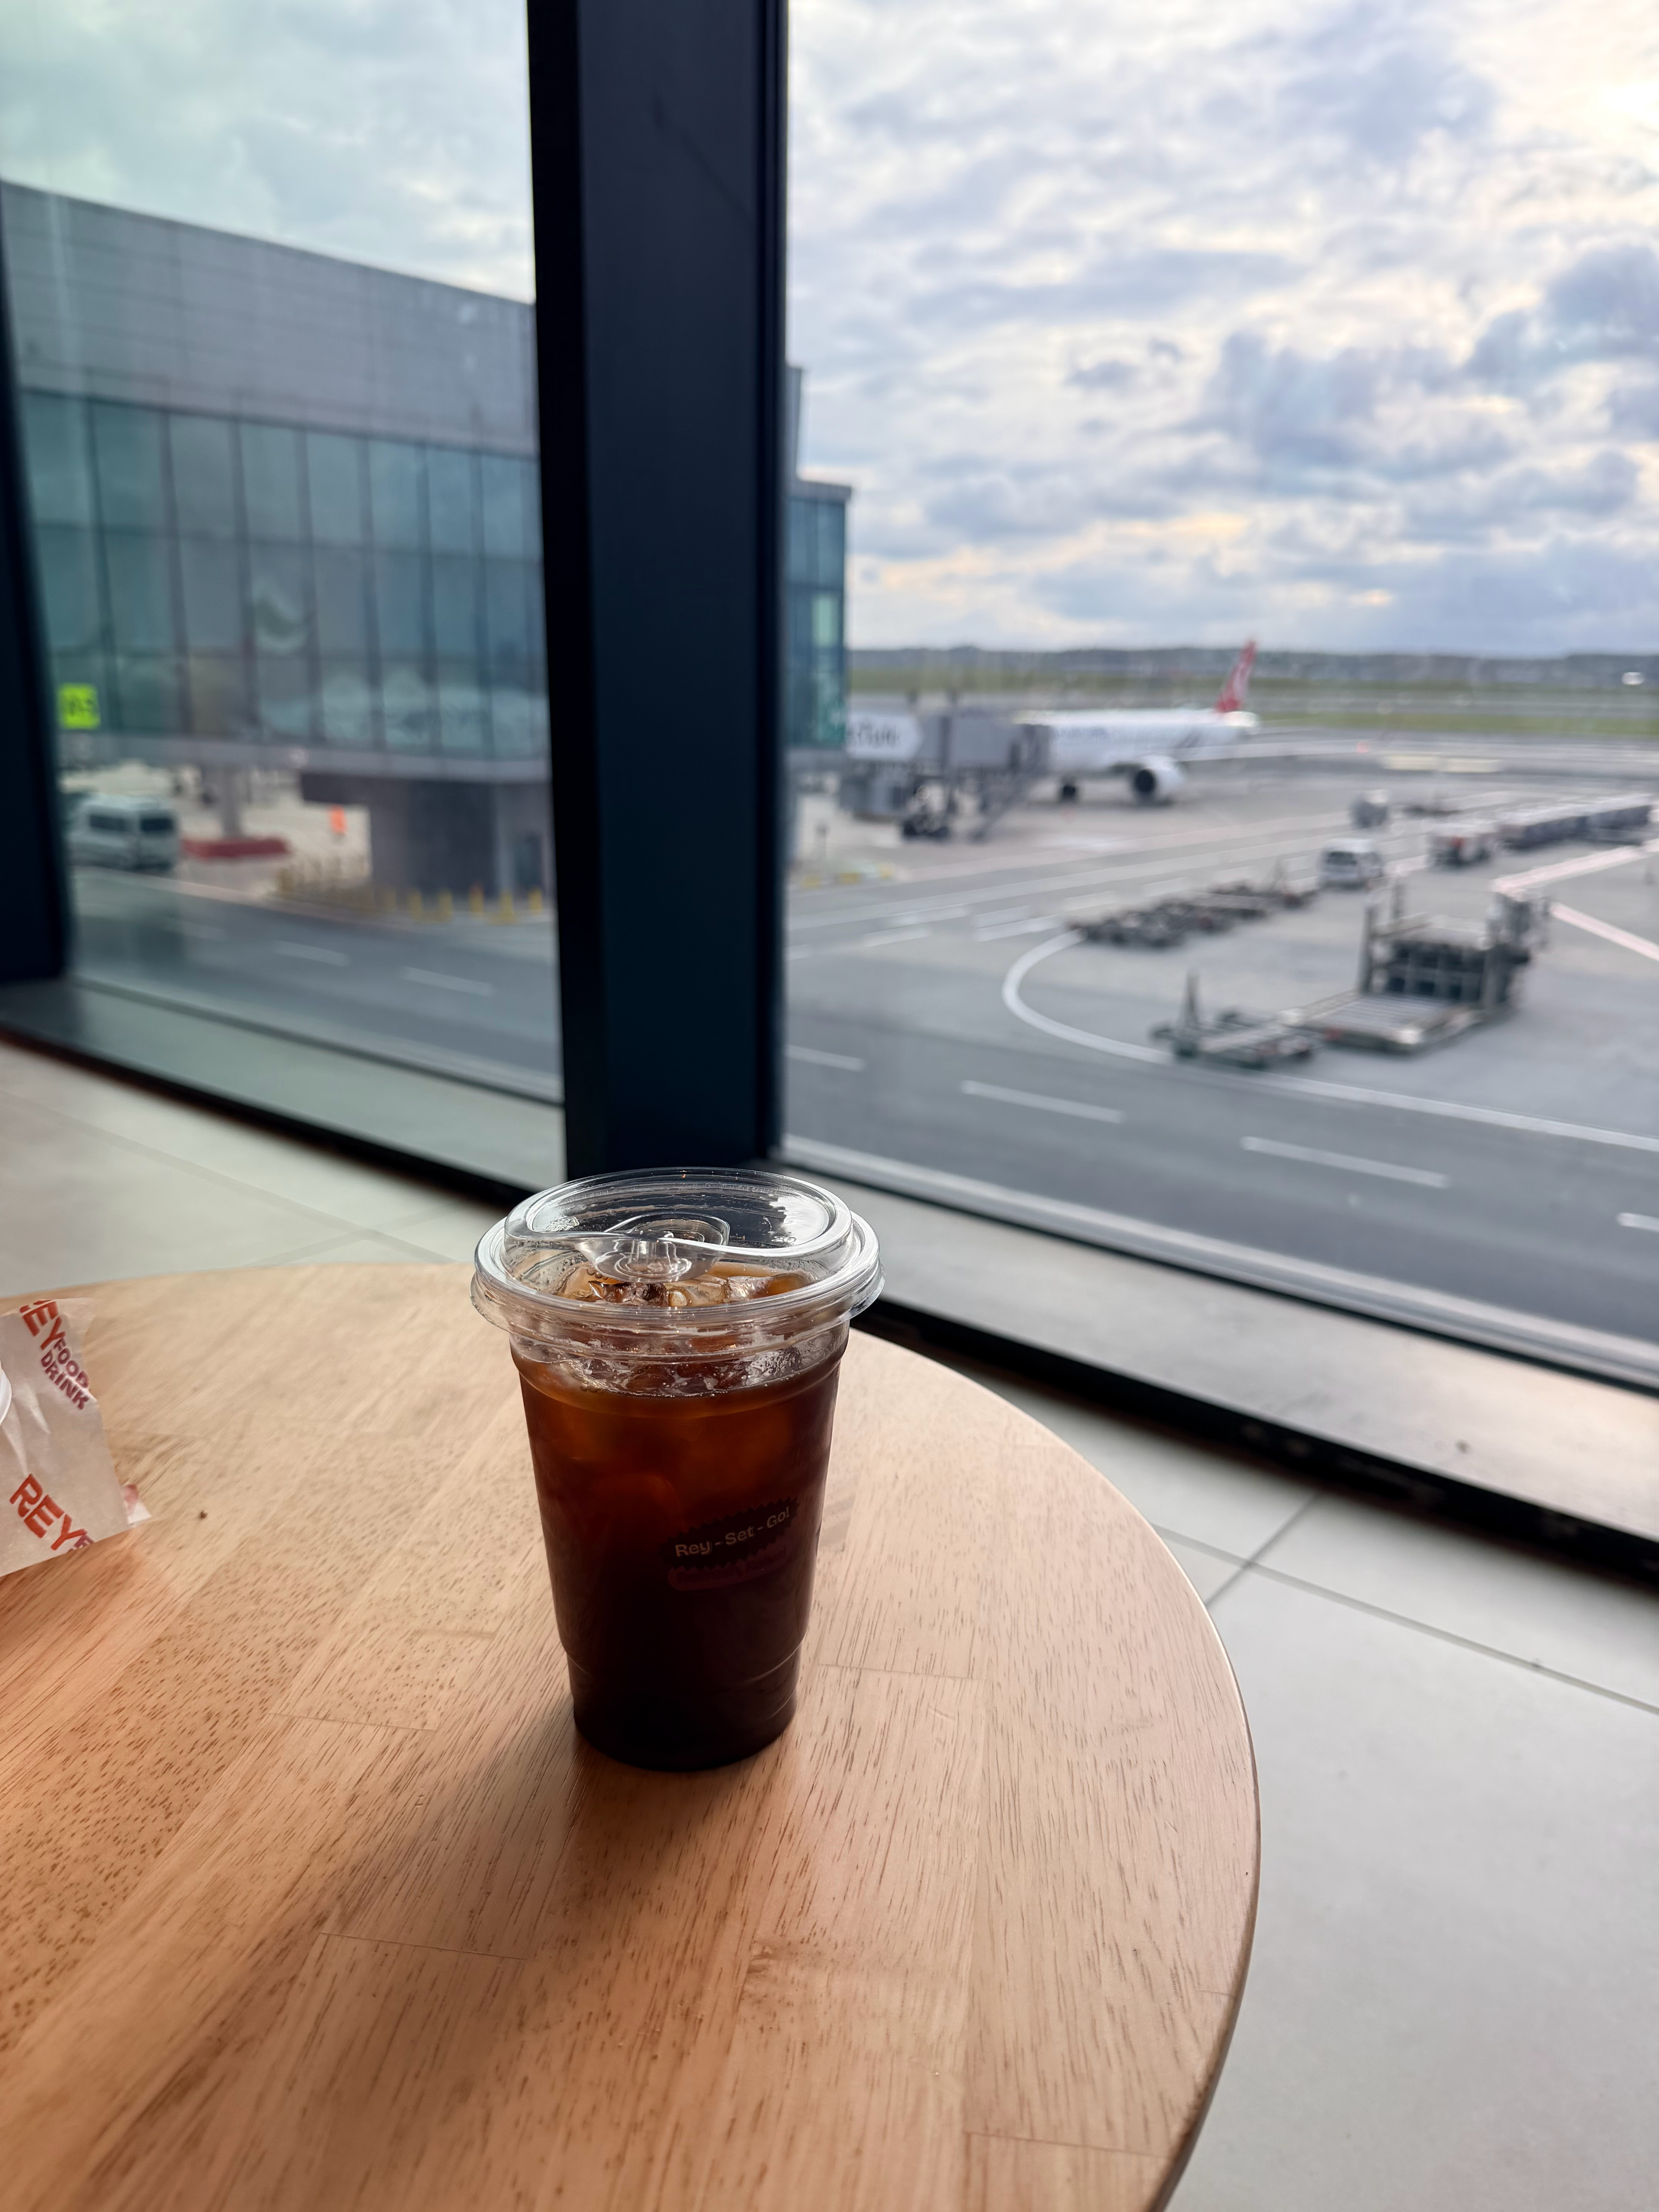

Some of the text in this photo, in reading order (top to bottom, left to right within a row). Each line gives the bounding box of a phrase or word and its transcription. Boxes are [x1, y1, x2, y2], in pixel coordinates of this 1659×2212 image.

[20, 1300, 66, 1350] EY
[41, 1349, 90, 1410] DRINK
[53, 1338, 89, 1388] FOOD
[10, 1474, 87, 1551] REY
[675, 1541, 712, 1558] Rey
[725, 1526, 754, 1545] Set
[766, 1506, 789, 1528] Go!
